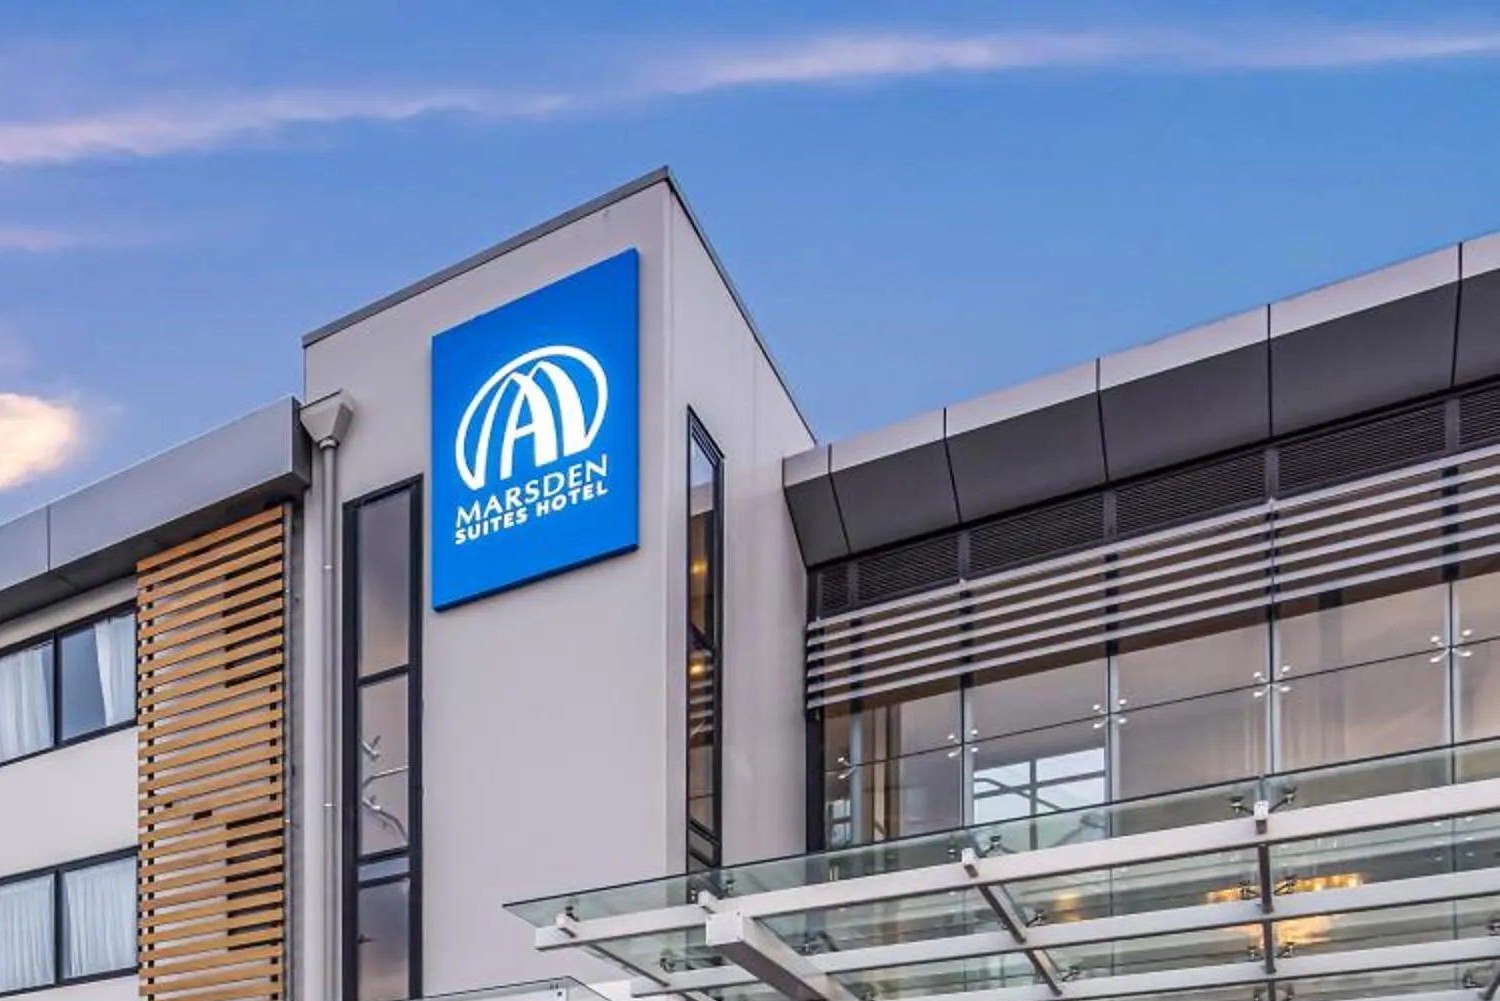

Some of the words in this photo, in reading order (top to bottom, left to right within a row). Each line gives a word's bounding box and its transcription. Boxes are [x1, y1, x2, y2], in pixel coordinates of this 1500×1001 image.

[455, 453, 608, 529] MARSDEN
[455, 507, 528, 545] SUITES
[536, 480, 609, 517] HOTEL
